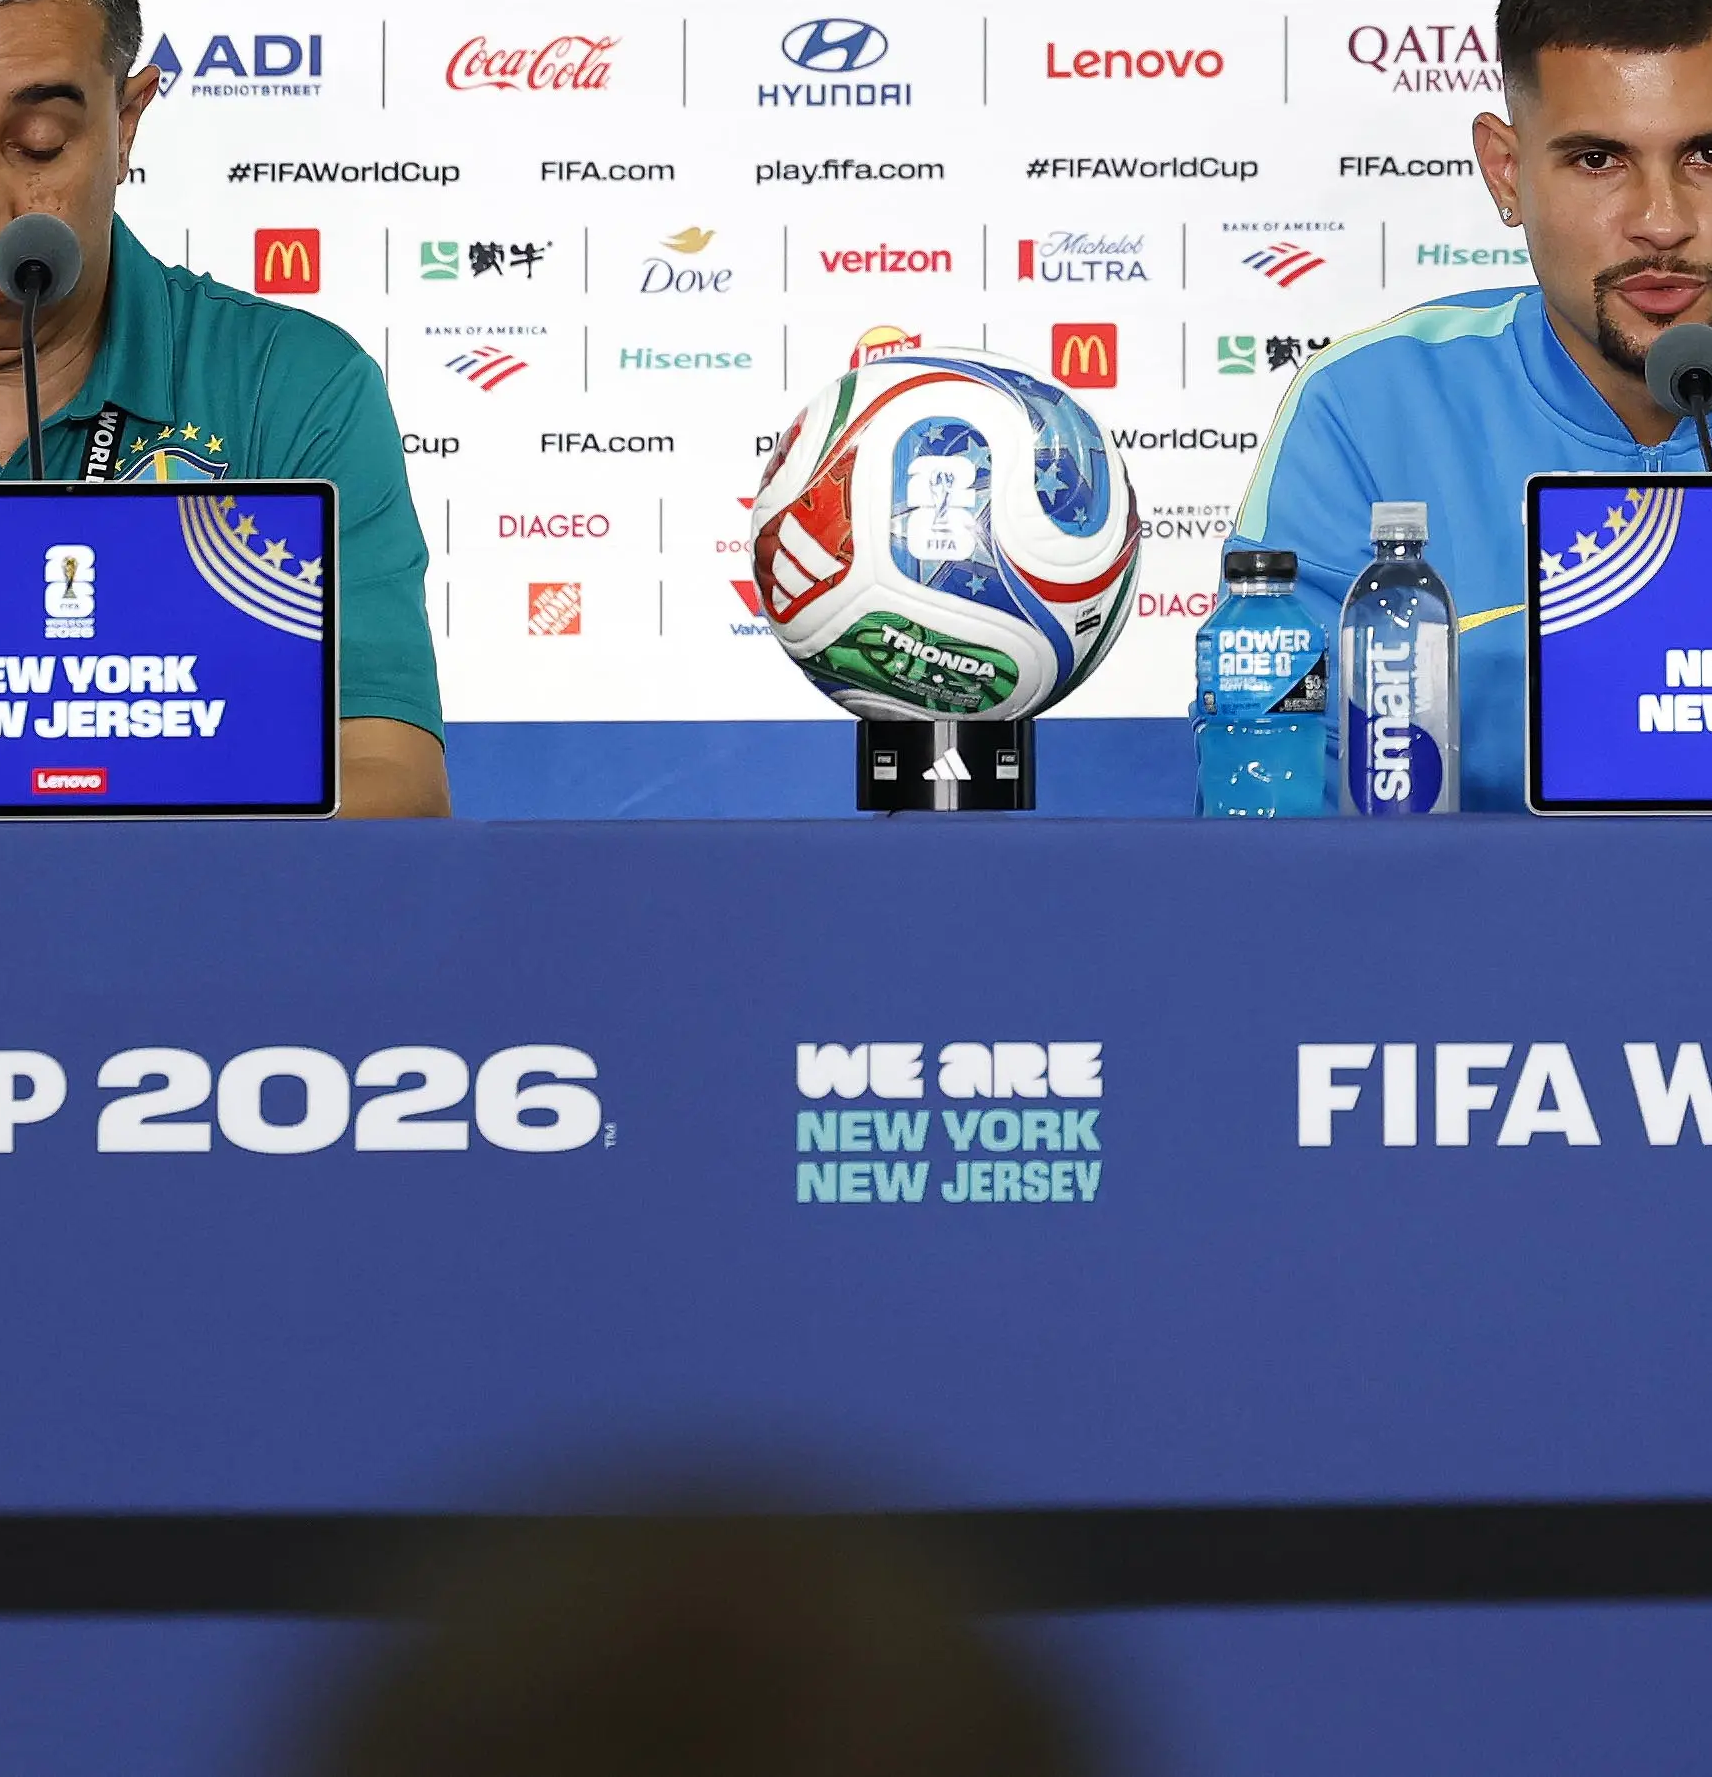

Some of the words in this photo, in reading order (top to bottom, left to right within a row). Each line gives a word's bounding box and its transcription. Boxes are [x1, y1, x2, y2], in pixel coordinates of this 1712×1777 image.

[192, 34, 323, 78] ADI
[1046, 41, 1225, 80] Lenovo
[226, 160, 461, 187] #FIFAWorldCup
[541, 160, 675, 182] FIFA.com
[756, 158, 945, 186] play.fifa.com
[1339, 155, 1474, 178] FIFA.com
[640, 260, 733, 294] Dove
[1040, 260, 1147, 283] ULTRA
[620, 348, 752, 369] Hisense
[540, 432, 674, 454] FIFA.com
[498, 514, 610, 539] DIAGEO
[926, 540, 957, 551] FIFA
[880, 623, 996, 678] TRIONDA
[1218, 629, 1310, 652] POWER
[62, 654, 199, 694] YORK
[1218, 653, 1271, 676] ADE
[33, 699, 226, 739] JERSEY
[1371, 640, 1413, 803] smart
[37, 773, 101, 790] Lenovo
[797, 1043, 924, 1099] WE
[938, 1042, 1103, 1098] ARE
[97, 1044, 602, 1154] 2026
[1297, 1042, 1602, 1147] FIFA
[796, 1109, 930, 1152] NEW
[941, 1108, 1102, 1152] YORK
[796, 1160, 930, 1203] NEW
[940, 1159, 1102, 1203] JERSEY
